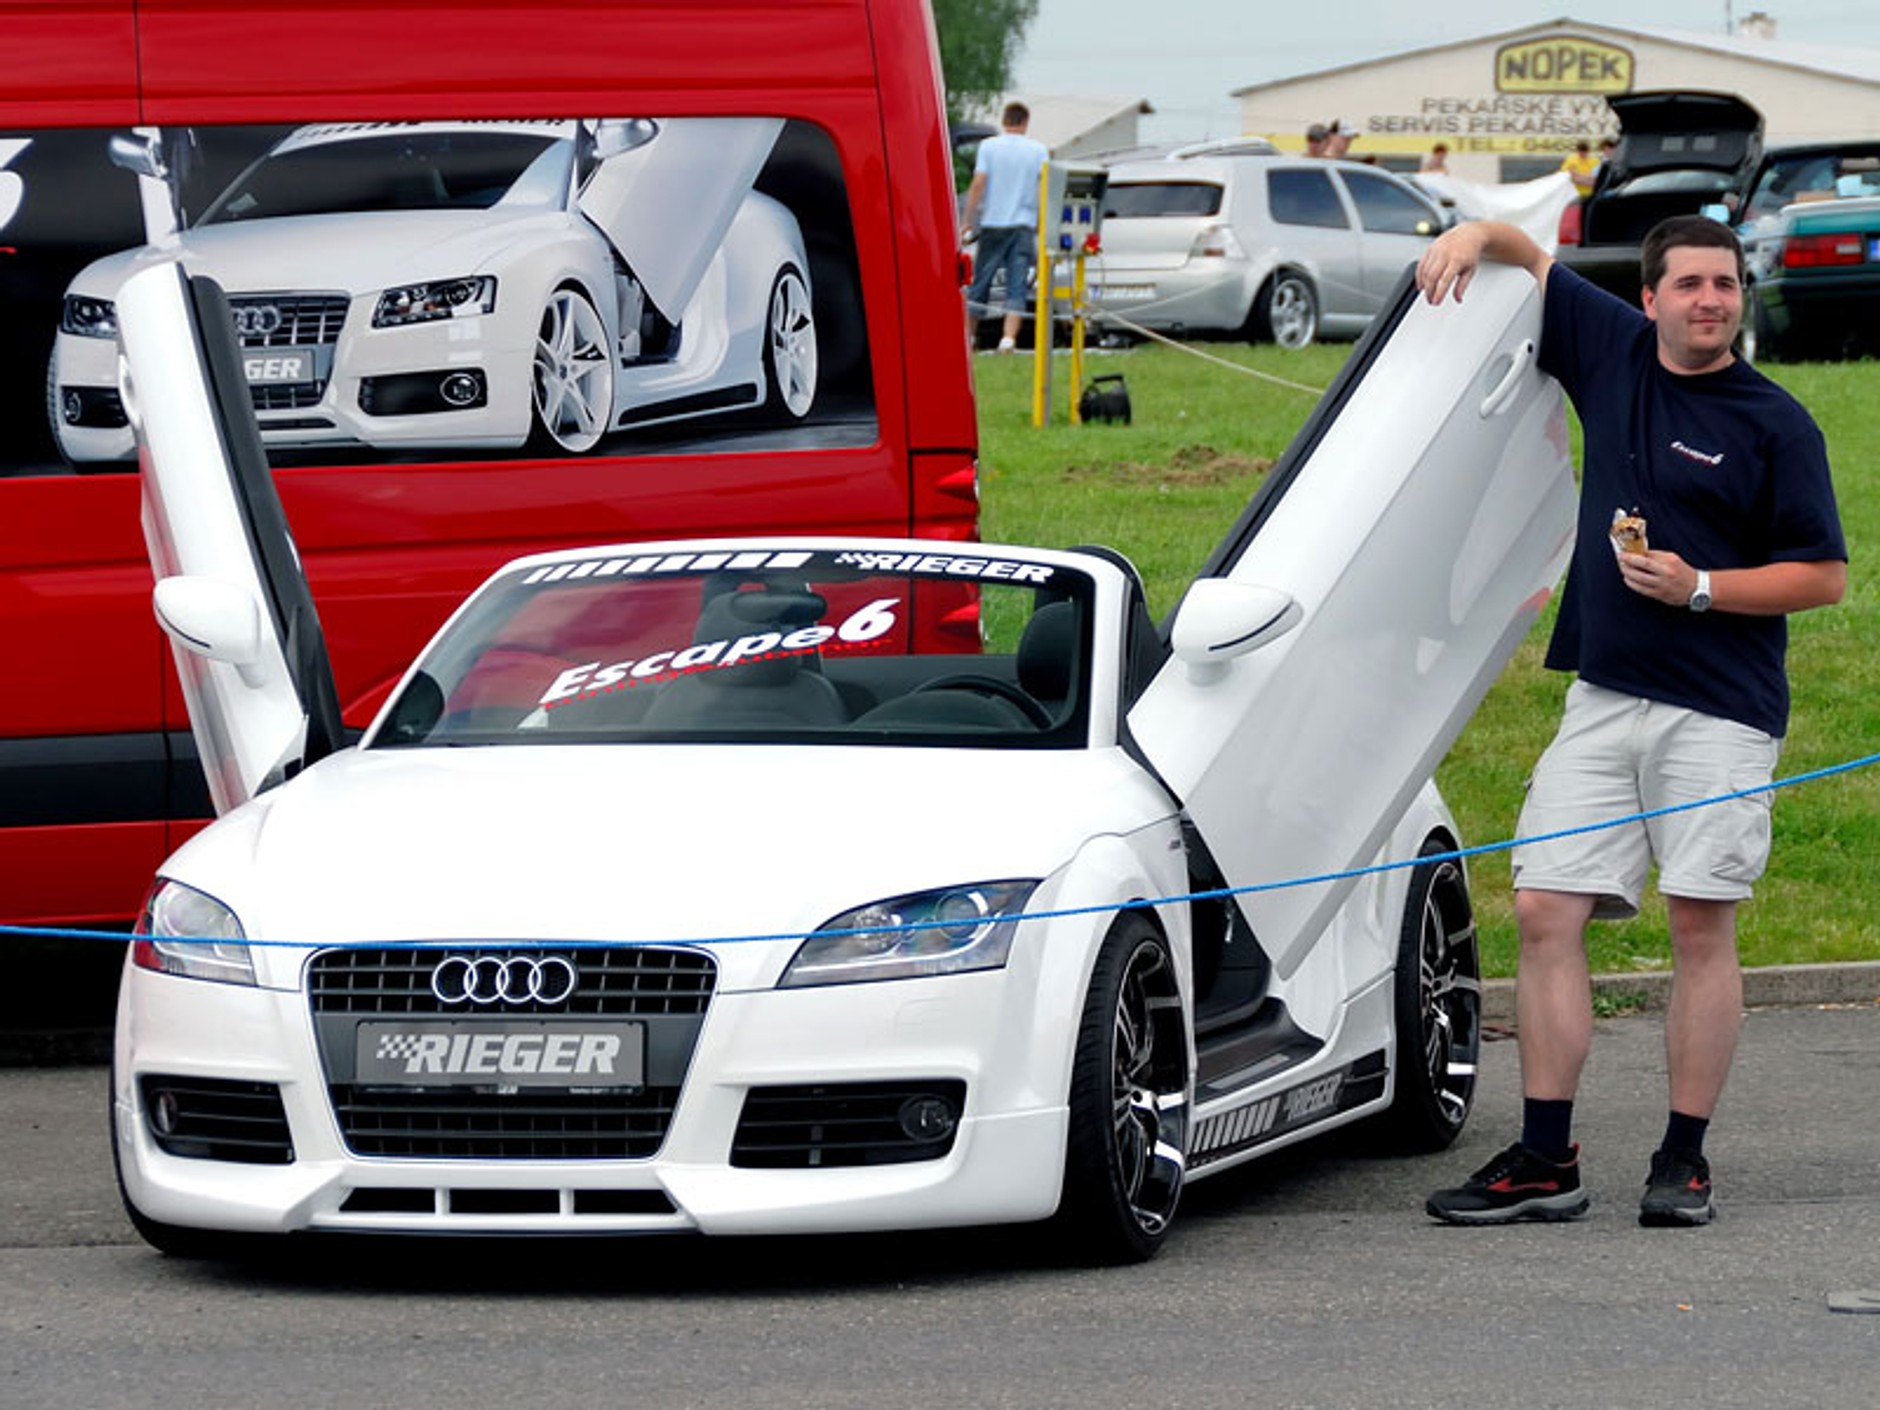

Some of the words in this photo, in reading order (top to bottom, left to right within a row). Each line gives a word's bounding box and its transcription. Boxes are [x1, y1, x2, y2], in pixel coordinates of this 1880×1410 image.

[1503, 47, 1625, 81] NOPEK
[1367, 115, 1460, 133] SERVIS
[244, 358, 302, 380] GER
[859, 553, 1054, 583] RIEGER
[539, 598, 900, 704] Escape6
[404, 1034, 621, 1074] RIEGER
